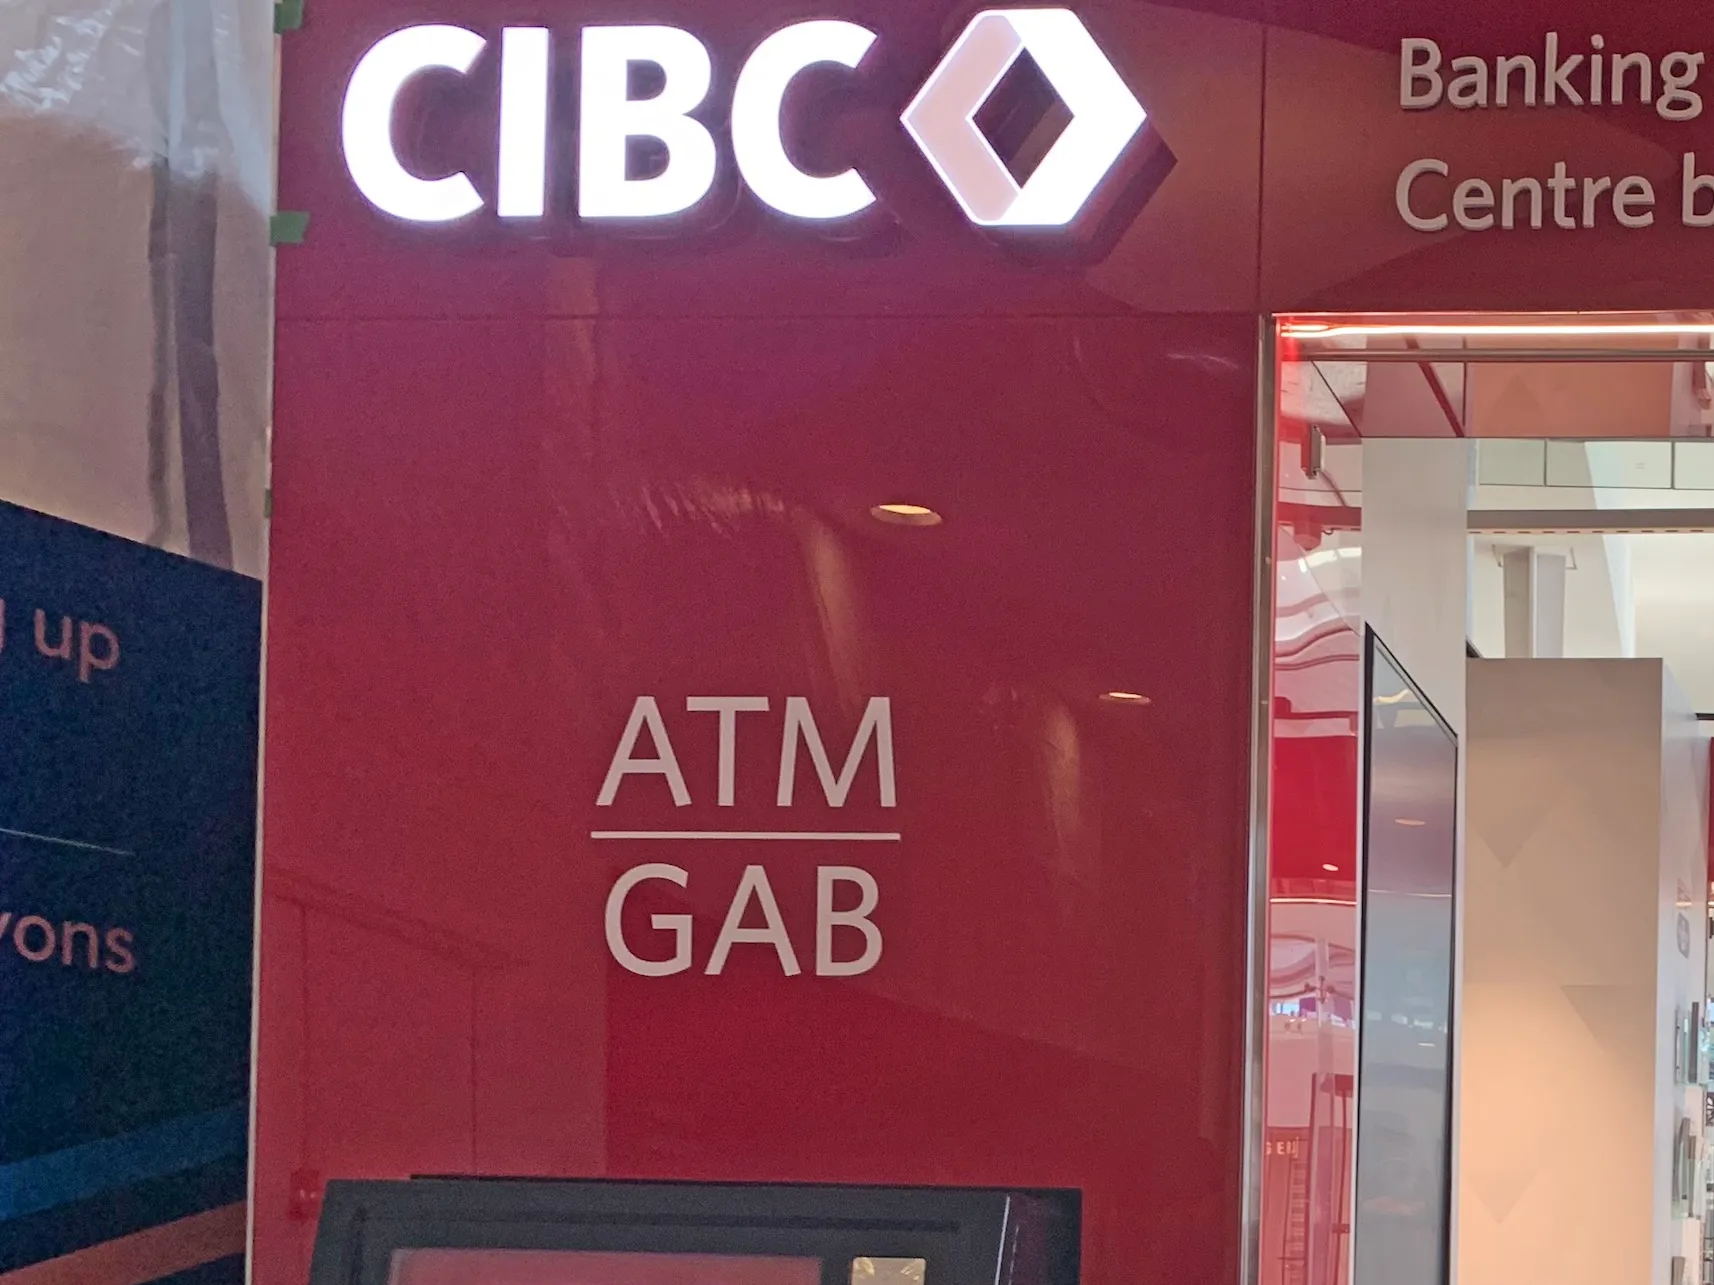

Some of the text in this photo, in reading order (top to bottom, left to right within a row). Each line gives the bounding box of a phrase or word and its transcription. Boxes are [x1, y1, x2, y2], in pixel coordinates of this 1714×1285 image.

[341, 19, 878, 224] CIBC
[1398, 31, 1706, 122] Banking
[1394, 157, 1656, 233] Centre
[32, 606, 121, 684] up
[595, 695, 900, 811] ATM
[604, 862, 884, 977] GAB
